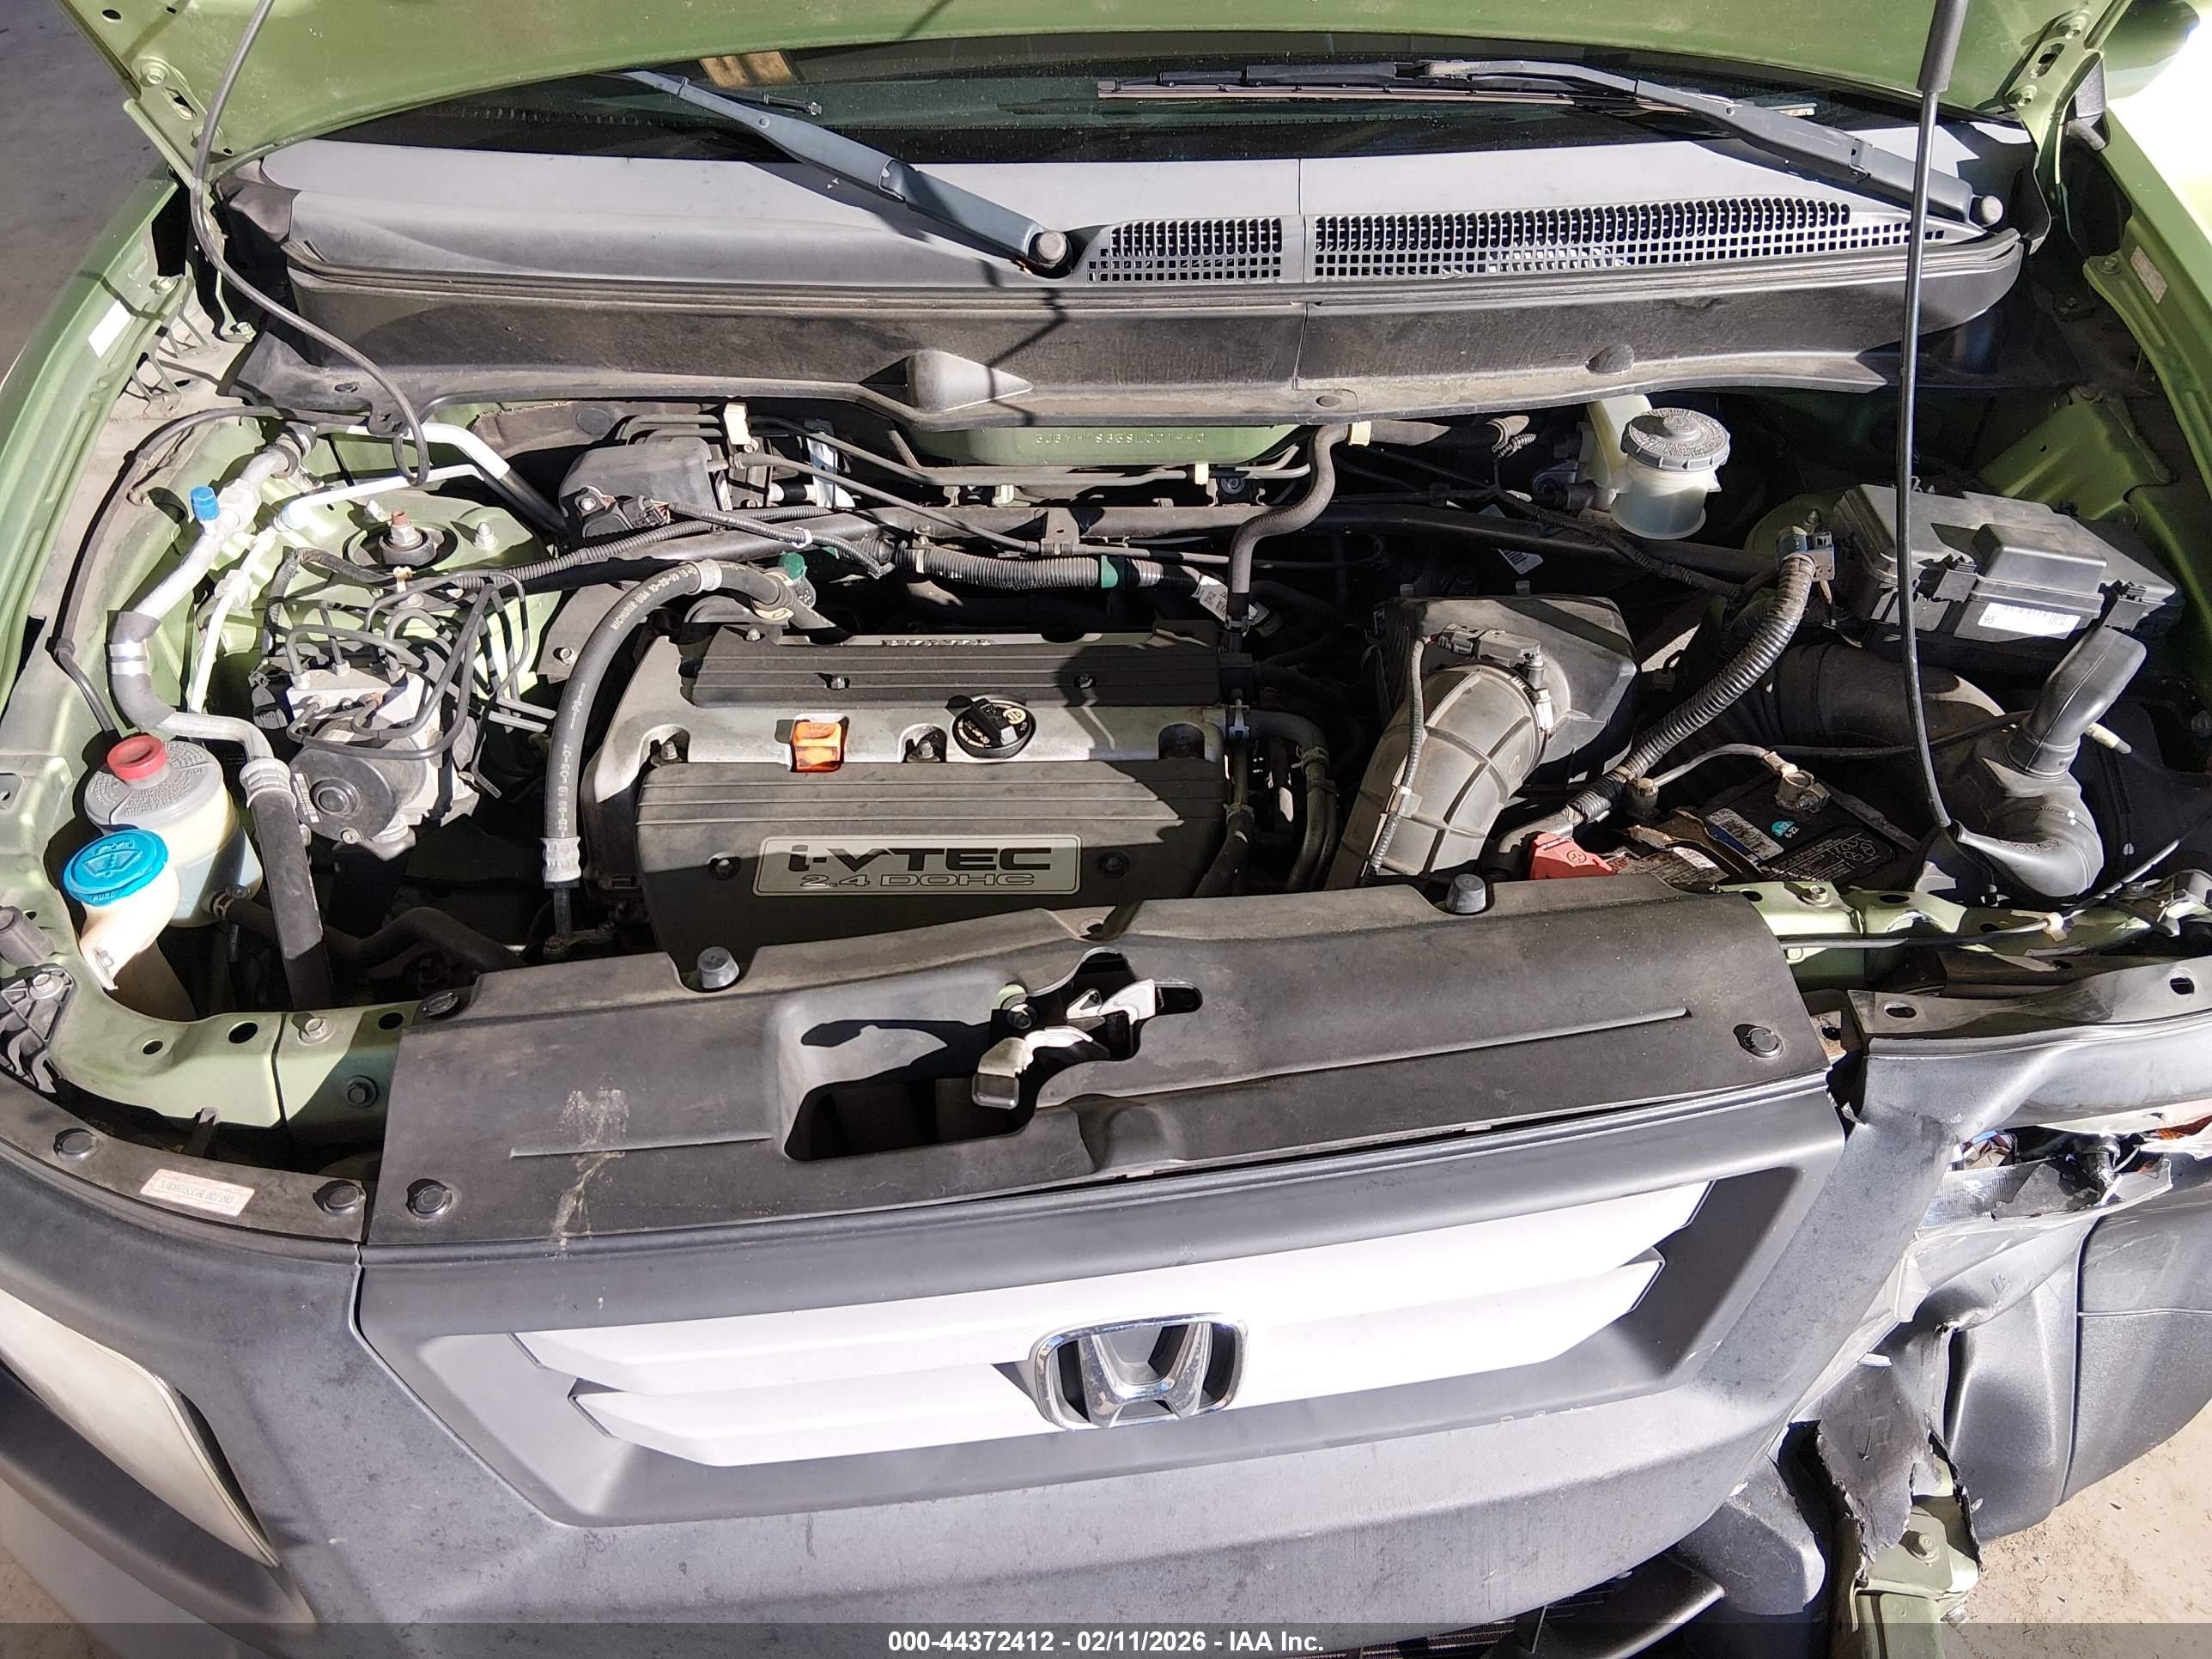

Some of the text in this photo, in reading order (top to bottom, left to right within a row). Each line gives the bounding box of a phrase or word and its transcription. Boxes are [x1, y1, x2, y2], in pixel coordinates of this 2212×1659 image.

[787, 844, 1052, 872] i-VTEC
[799, 872, 1036, 888] 2.4 DOHC
